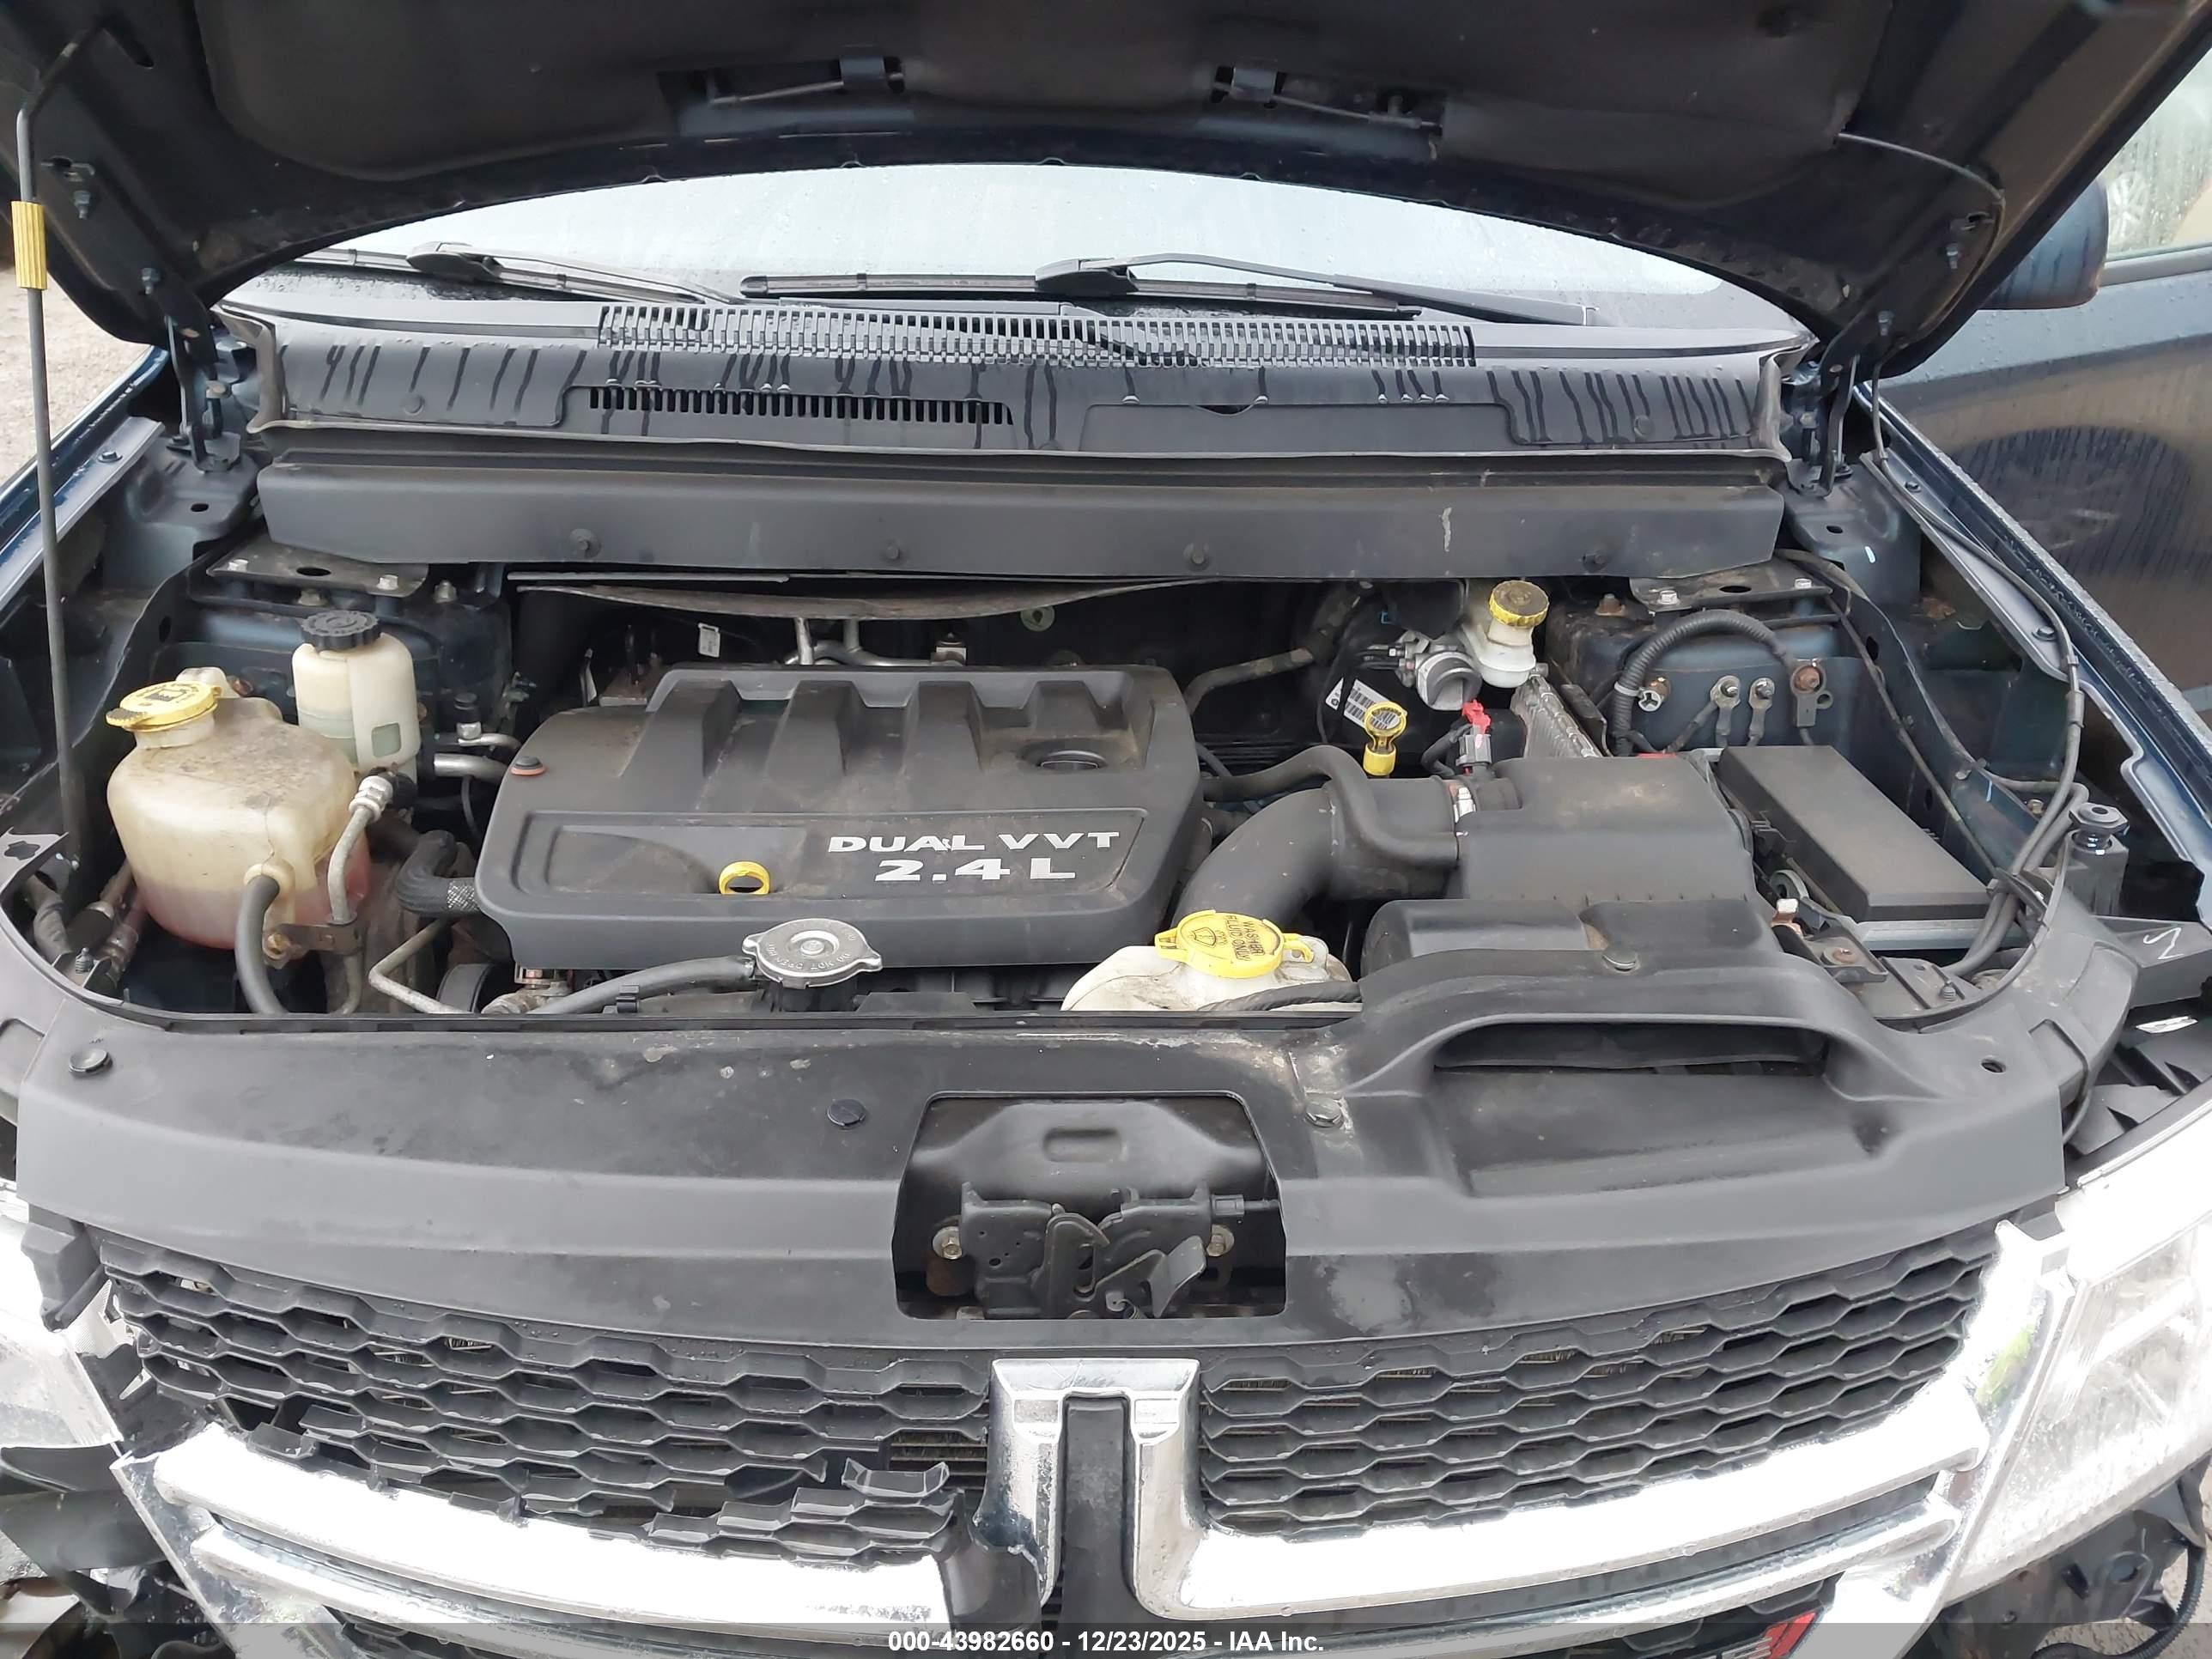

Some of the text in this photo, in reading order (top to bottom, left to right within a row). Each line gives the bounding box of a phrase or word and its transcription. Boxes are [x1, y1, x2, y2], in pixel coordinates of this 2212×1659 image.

[828, 832, 1120, 853] DUAL VVT
[1226, 915, 1251, 961] FLUID ONLY
[1243, 921, 1266, 956] WASHER
